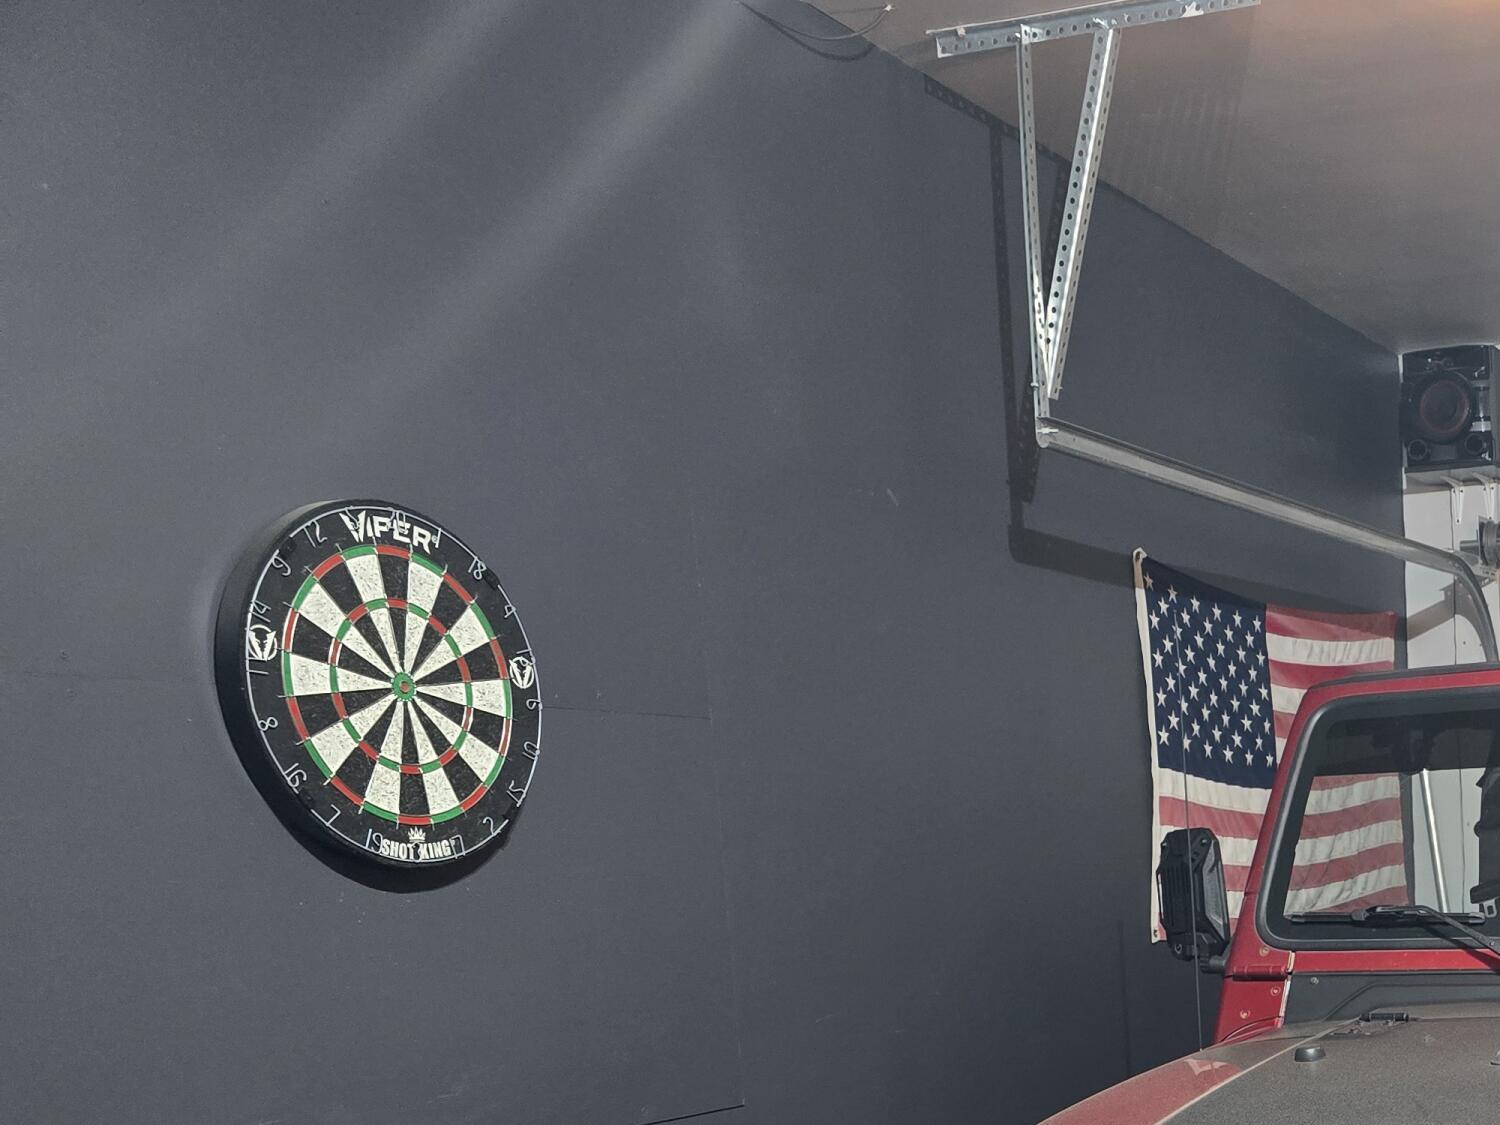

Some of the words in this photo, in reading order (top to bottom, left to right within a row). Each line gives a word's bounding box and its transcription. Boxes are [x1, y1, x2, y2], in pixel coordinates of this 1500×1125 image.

[302, 519, 328, 548] 12
[339, 510, 432, 555] VIPER
[468, 557, 487, 580] 18
[258, 716, 279, 732] 8
[382, 838, 416, 861] SHOT
[418, 839, 452, 861] KING
